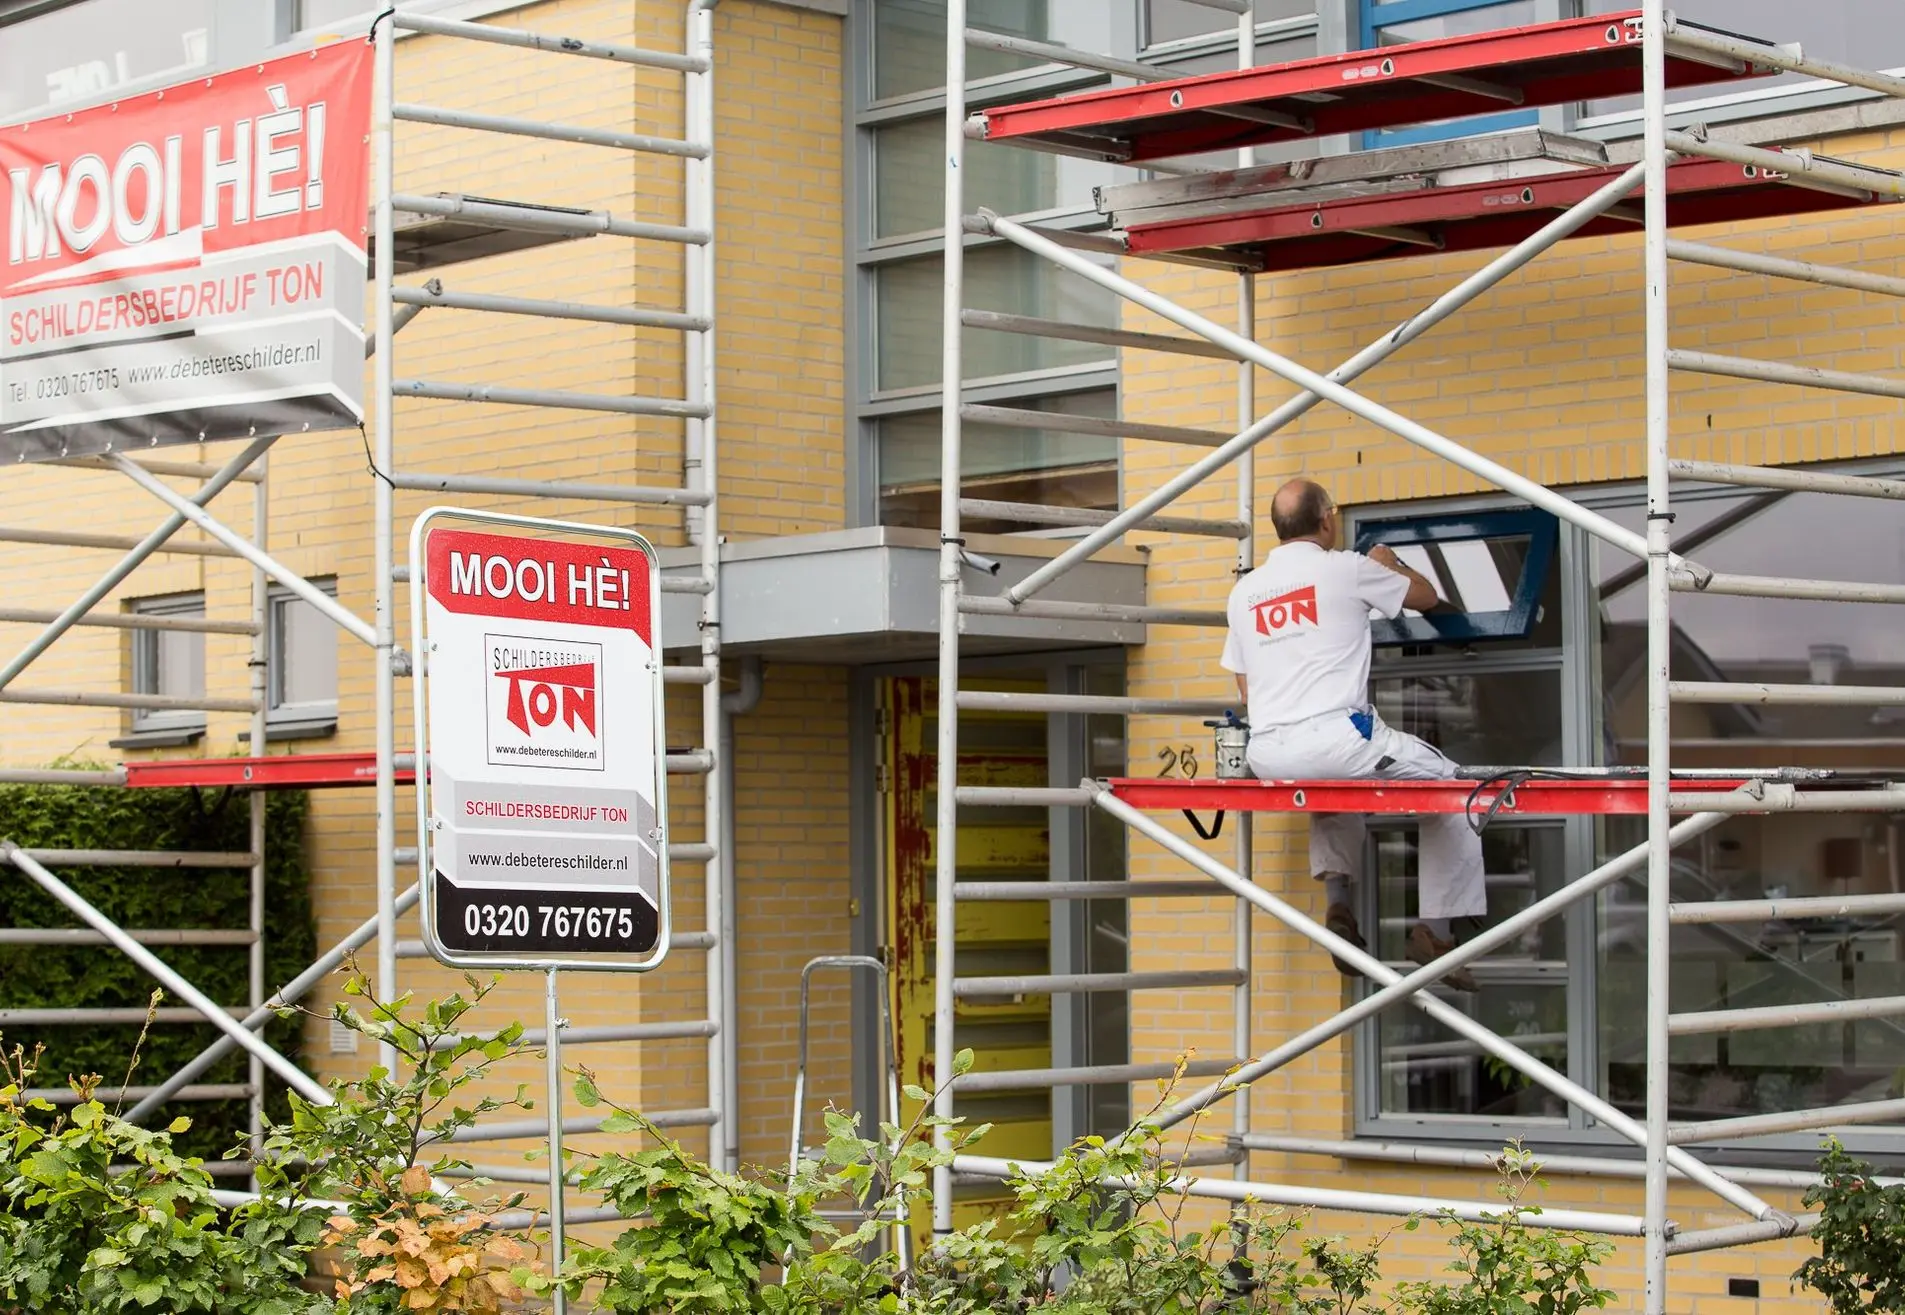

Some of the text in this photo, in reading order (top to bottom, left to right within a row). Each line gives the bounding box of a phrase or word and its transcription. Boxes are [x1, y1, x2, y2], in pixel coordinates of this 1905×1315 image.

[9, 84, 326, 265] MOOI HÈ!
[9, 261, 323, 345] SCHILDERSBEDRIJF TON
[9, 338, 321, 402] Tel. 0320 767675 www.debetereschilder.nl
[450, 551, 630, 611] MOOI HÈ!
[1248, 585, 1318, 636] TON
[494, 662, 596, 738] TON
[495, 745, 597, 760] www.debetereschilder.nl
[466, 800, 628, 822] SCHILDERSBEDRIJF TON
[468, 852, 628, 870] www.debetereschilder.nl
[464, 904, 633, 938] 0320 767675
